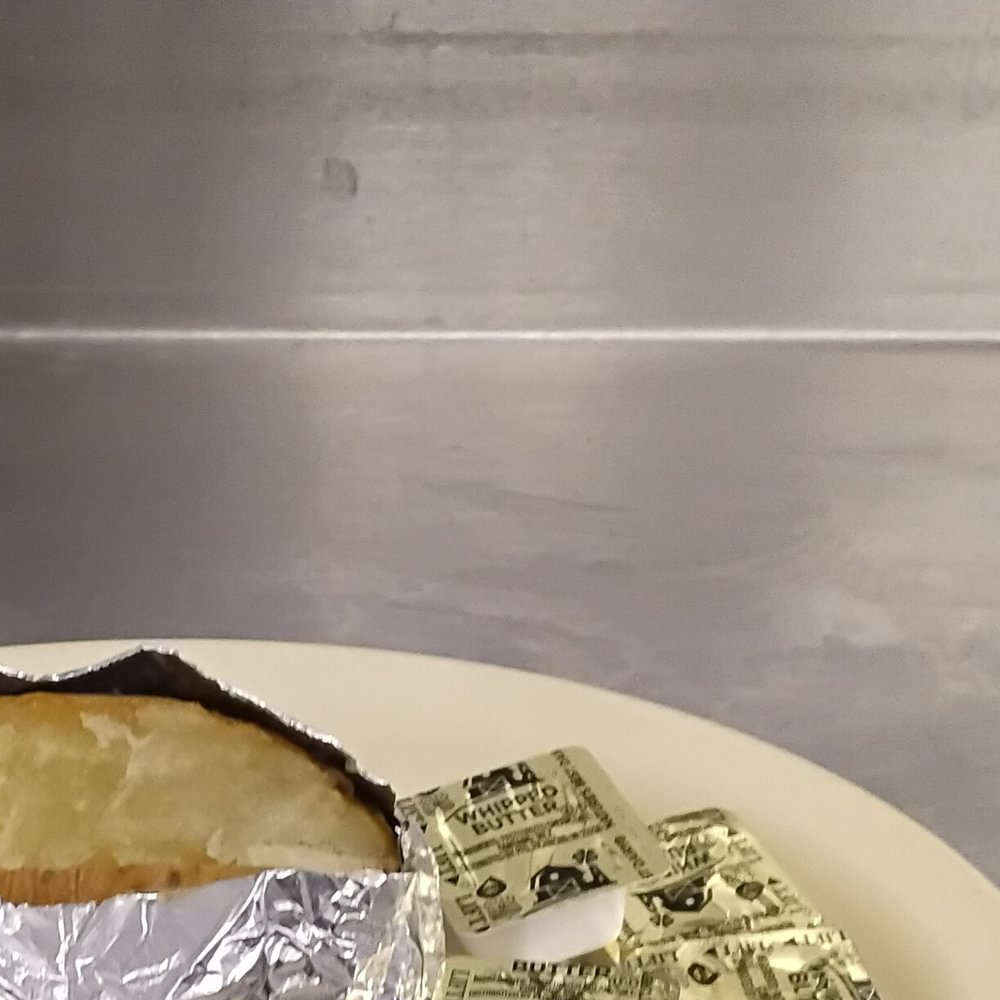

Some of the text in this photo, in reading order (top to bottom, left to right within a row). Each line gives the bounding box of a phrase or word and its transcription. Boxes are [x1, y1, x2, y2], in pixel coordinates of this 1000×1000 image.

[454, 785, 558, 825] WHIPPED
[472, 801, 557, 836] BUTTER
[512, 959, 611, 977] BUTTER
